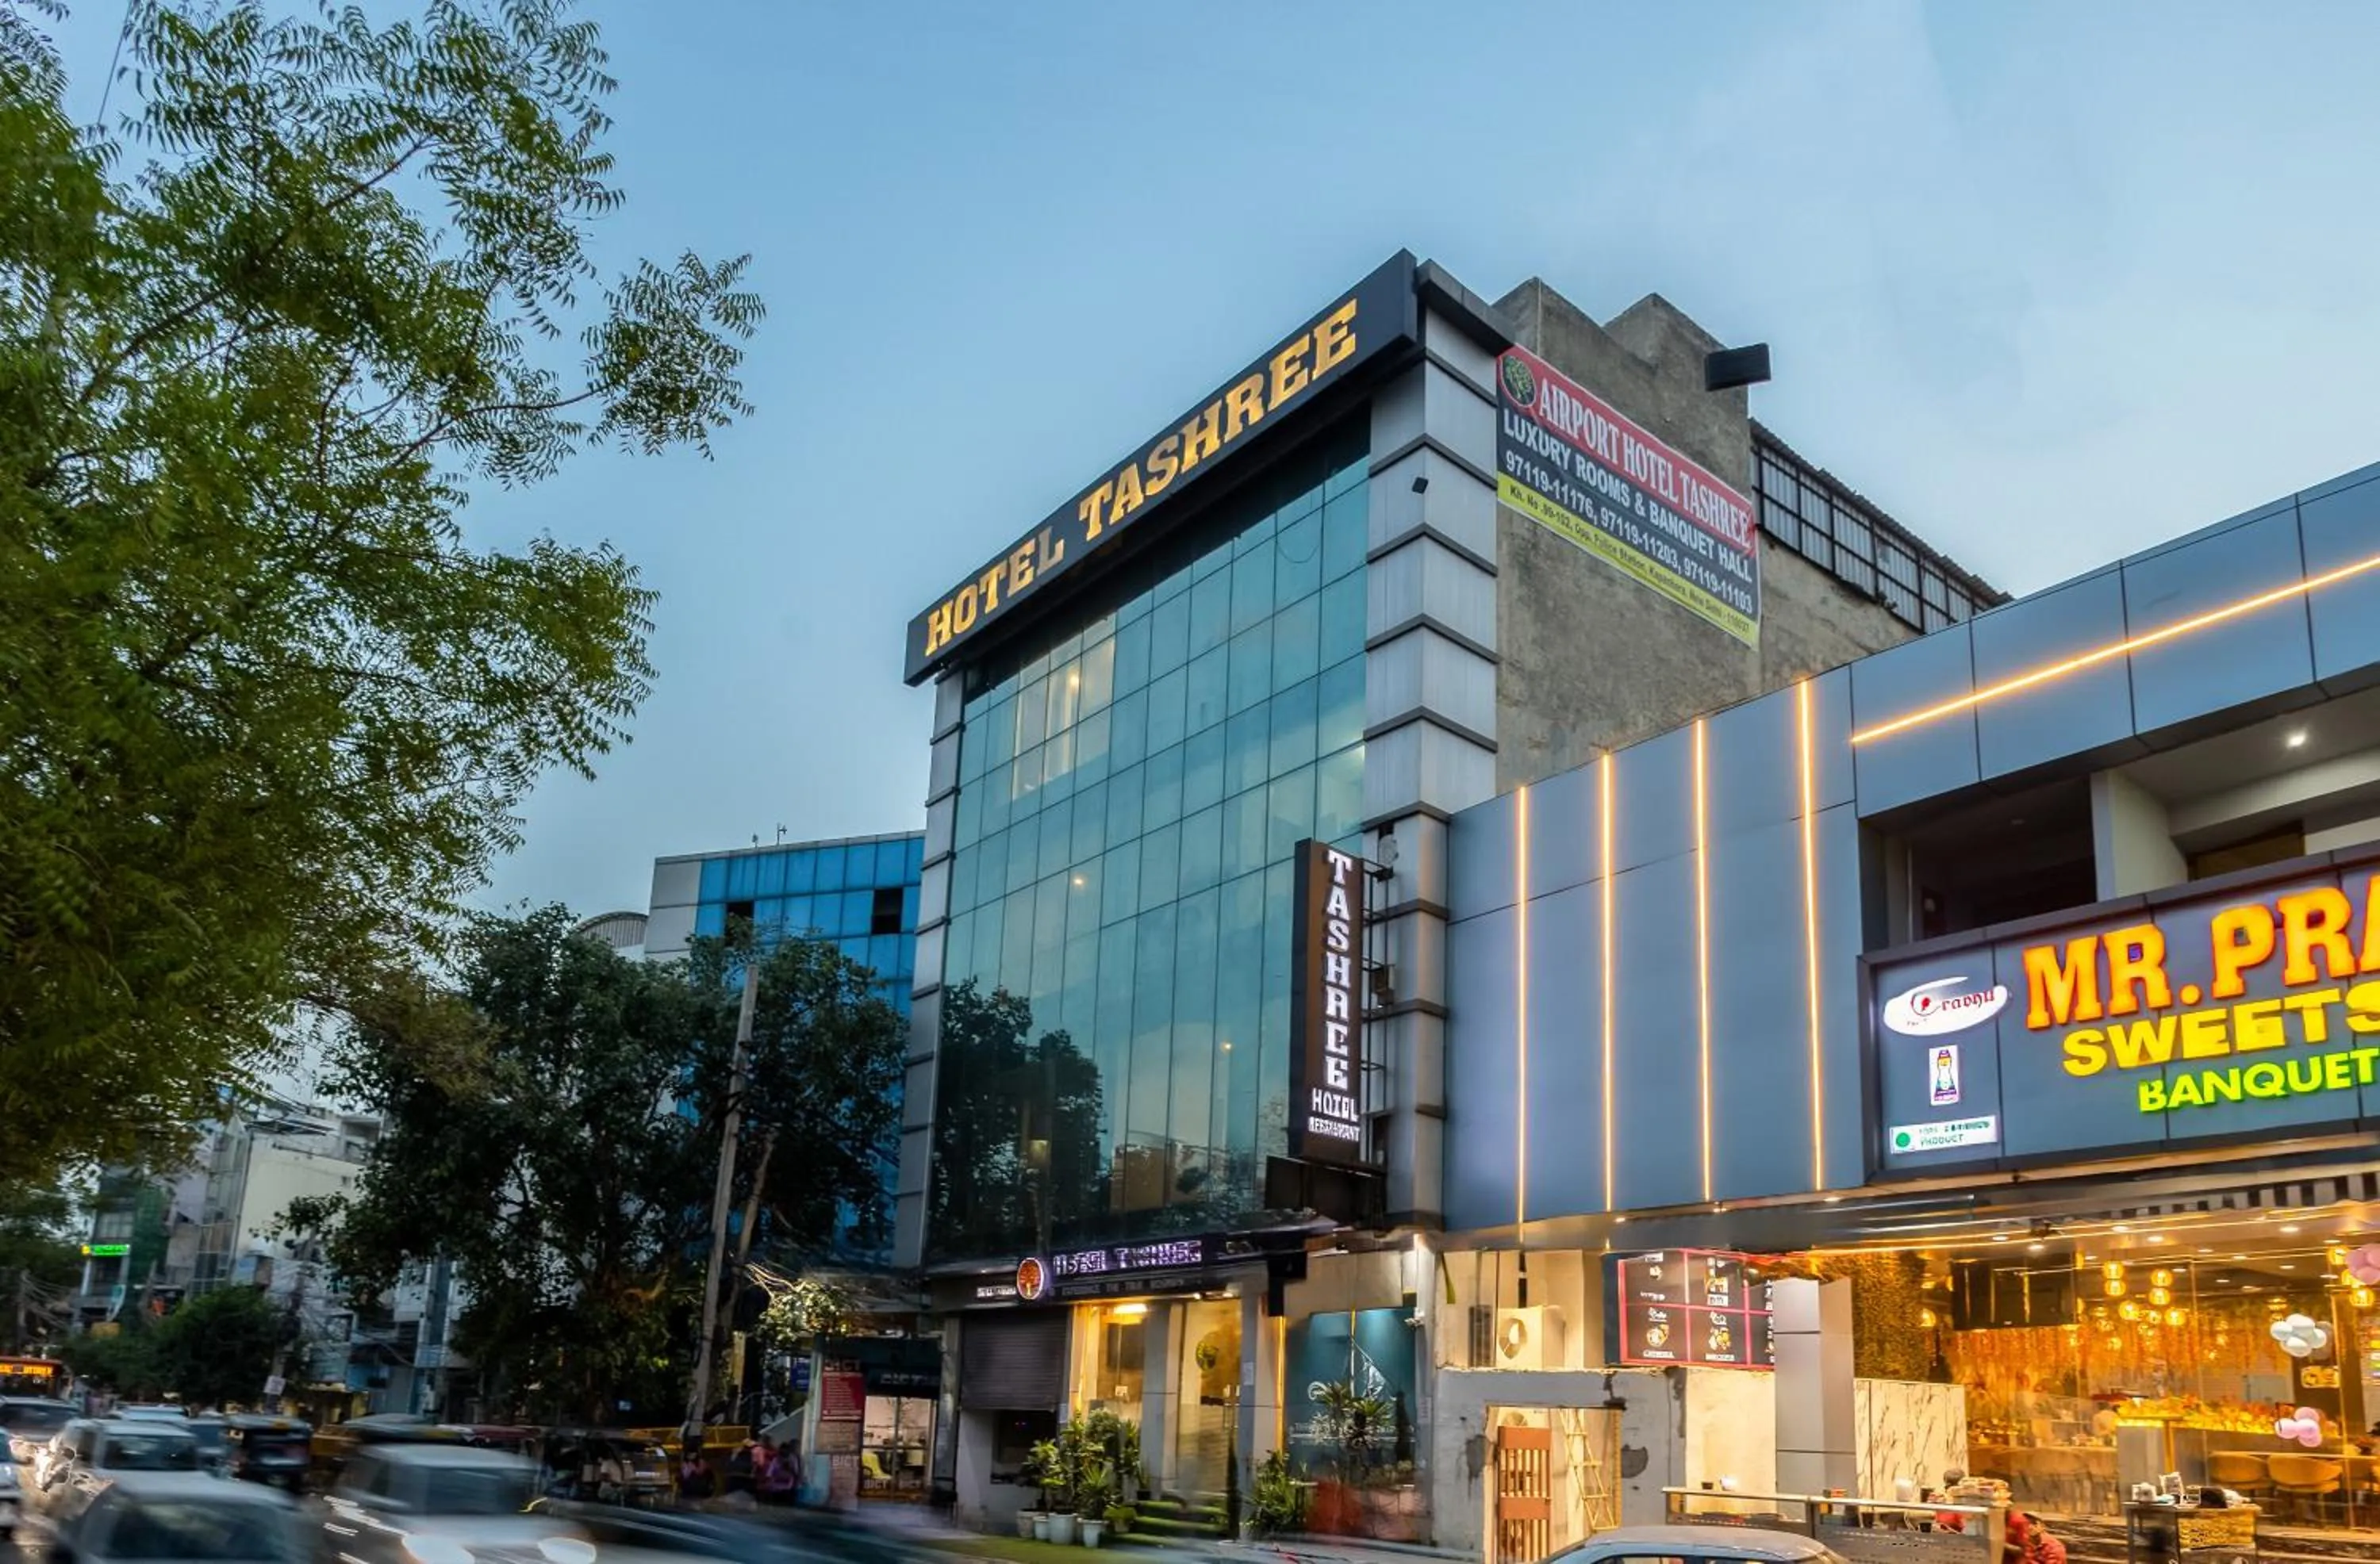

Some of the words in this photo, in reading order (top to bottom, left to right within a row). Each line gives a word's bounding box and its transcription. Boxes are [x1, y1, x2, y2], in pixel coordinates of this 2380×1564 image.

[924, 526, 1065, 657] HOTEL
[1079, 297, 1357, 541] TASHREE
[1503, 408, 1572, 471] LUXURY
[1576, 452, 1631, 506] ROOMS
[1634, 492, 1646, 518] &
[1649, 500, 1715, 559] BANQUET
[1718, 542, 1752, 583] HALL
[1539, 378, 1620, 465] AIRPORT
[1623, 433, 1679, 504] HOTEL
[1679, 470, 1752, 550] TASHREE
[1325, 849, 1352, 1090] TASHREE
[2022, 922, 2202, 1029] MR.
[2063, 979, 2380, 1077] SWEETS
[1312, 1087, 1359, 1122] HOTEL
[2138, 1047, 2380, 1113] BANQUET
